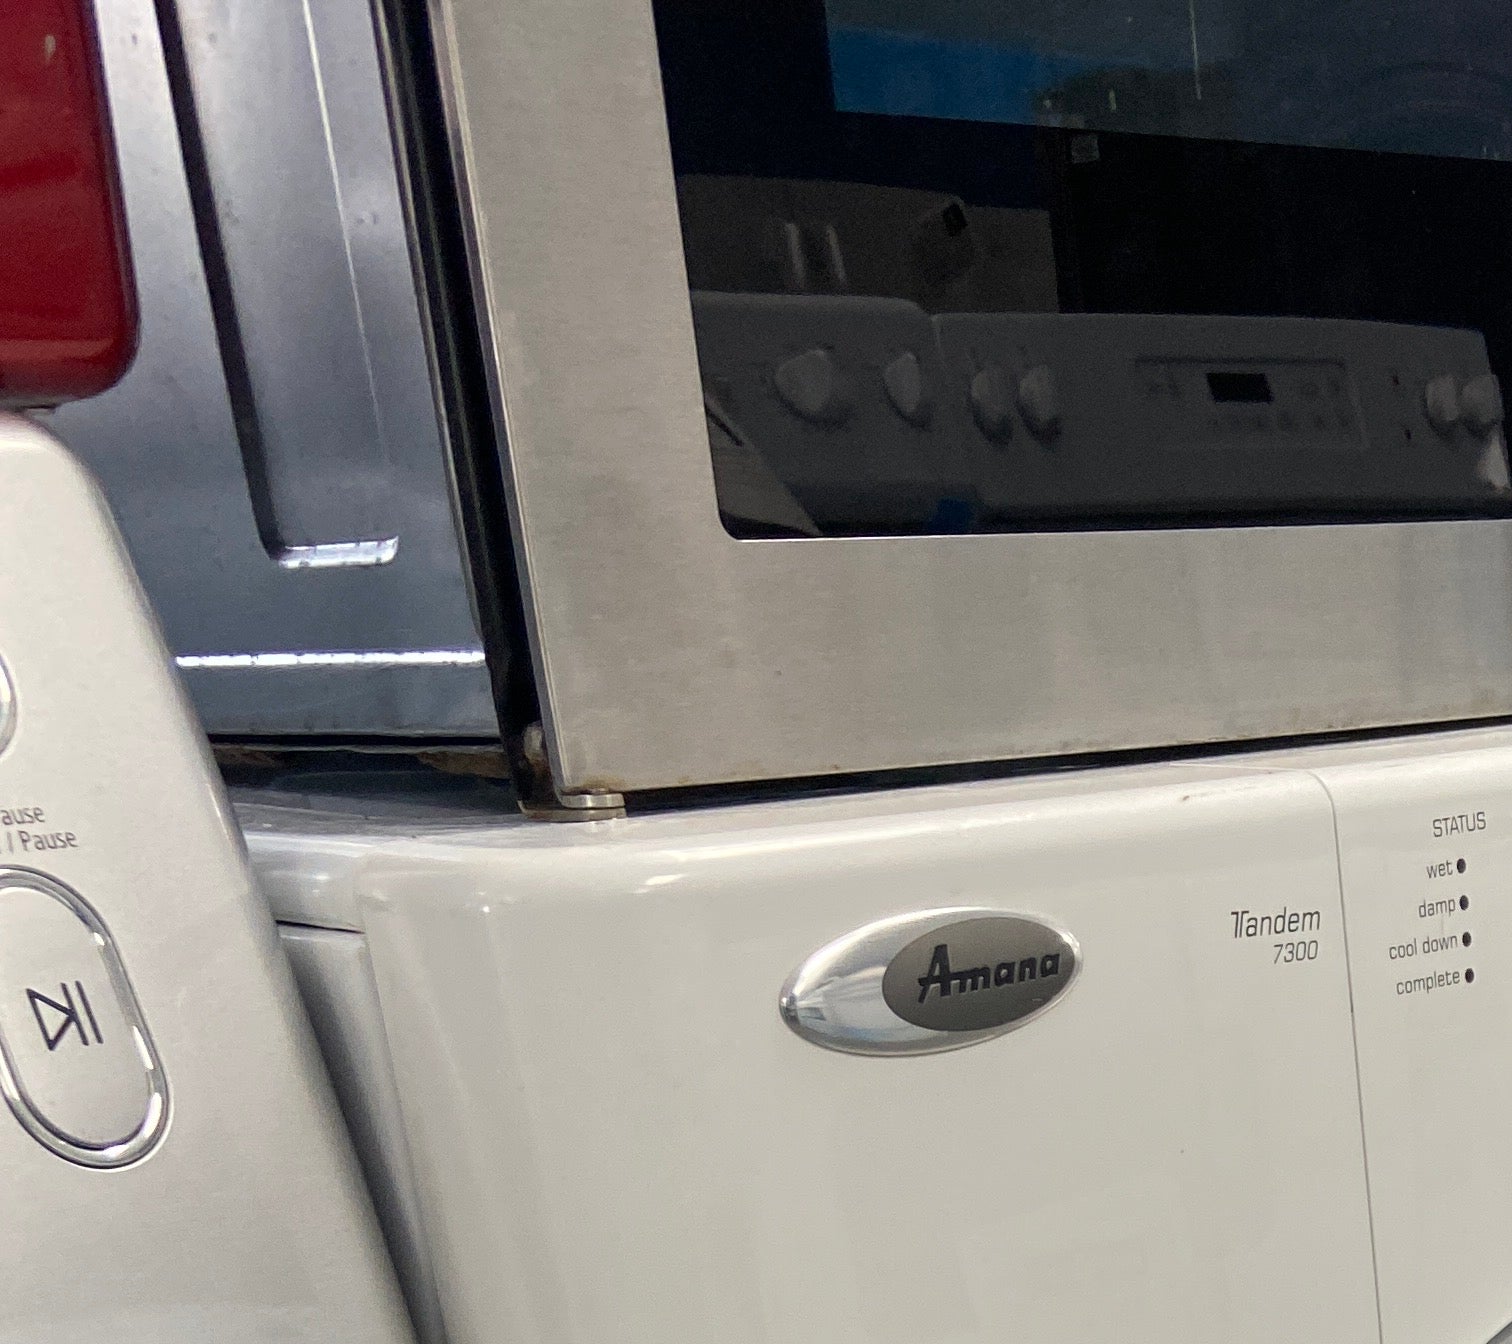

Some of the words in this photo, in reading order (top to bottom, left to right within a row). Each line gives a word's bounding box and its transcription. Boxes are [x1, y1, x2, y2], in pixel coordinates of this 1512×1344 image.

[0, 807, 45, 826] ause
[1432, 811, 1487, 838] STATUS
[18, 830, 79, 851] Pause
[1426, 860, 1454, 879] wet
[1418, 898, 1456, 918] damp
[1230, 907, 1321, 939] Tandem
[1272, 940, 1319, 965] 7300
[1389, 938, 1418, 960] cool
[1422, 934, 1458, 954] down
[917, 944, 1061, 1004] Amana
[1396, 971, 1461, 996] complete
